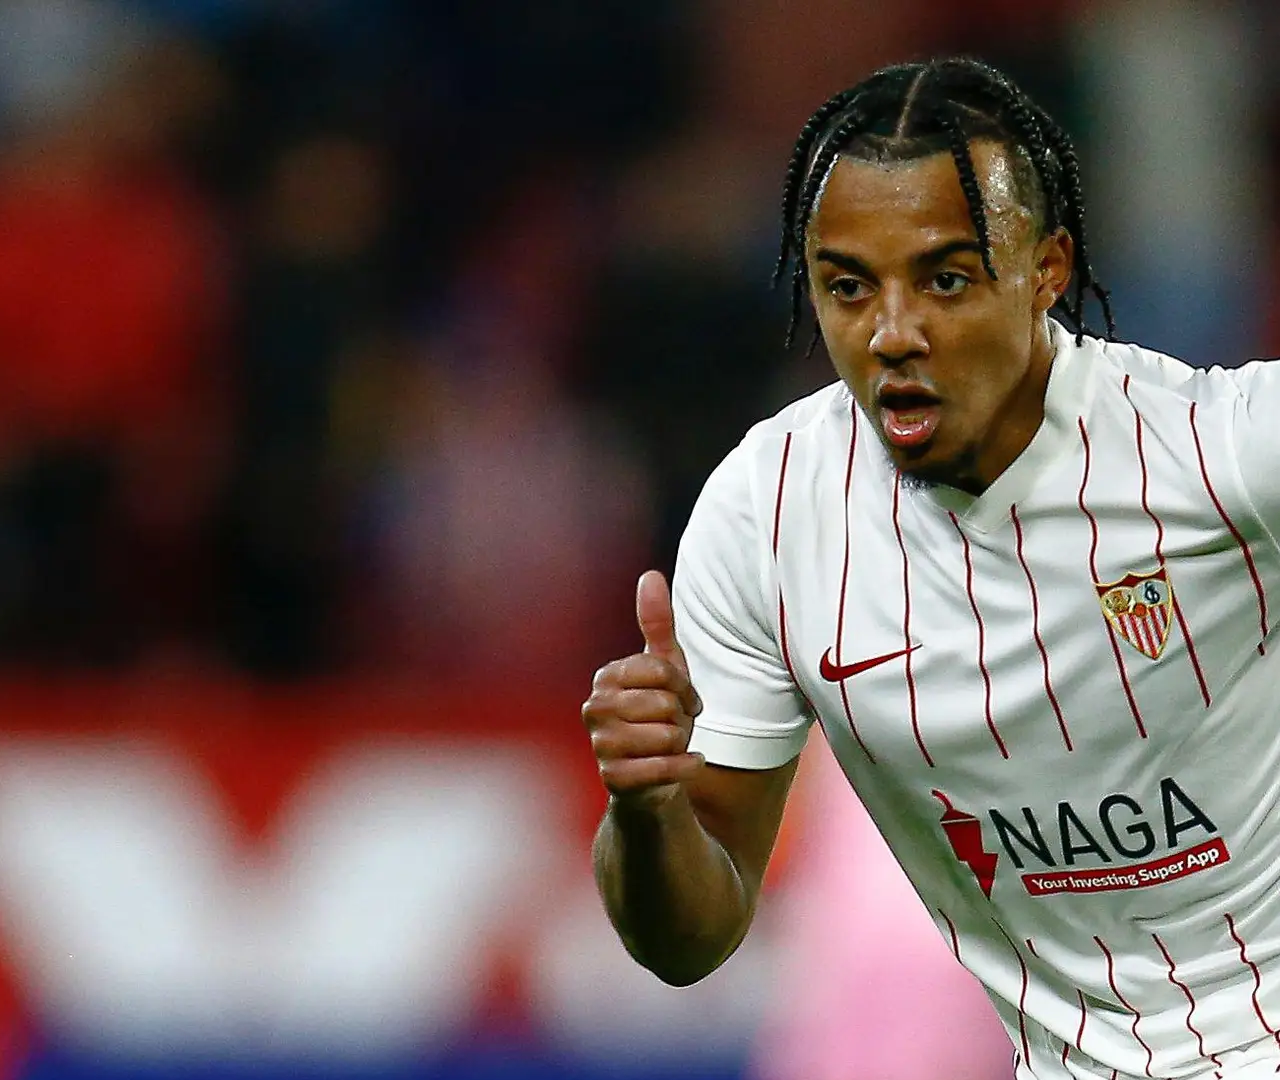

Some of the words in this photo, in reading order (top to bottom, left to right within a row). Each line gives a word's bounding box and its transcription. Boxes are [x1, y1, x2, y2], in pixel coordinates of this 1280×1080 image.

[988, 776, 1218, 870] NAGA
[1031, 877, 1070, 890] Your
[1069, 872, 1139, 889] Investing
[1138, 860, 1184, 882] Super
[1186, 847, 1220, 868] App
